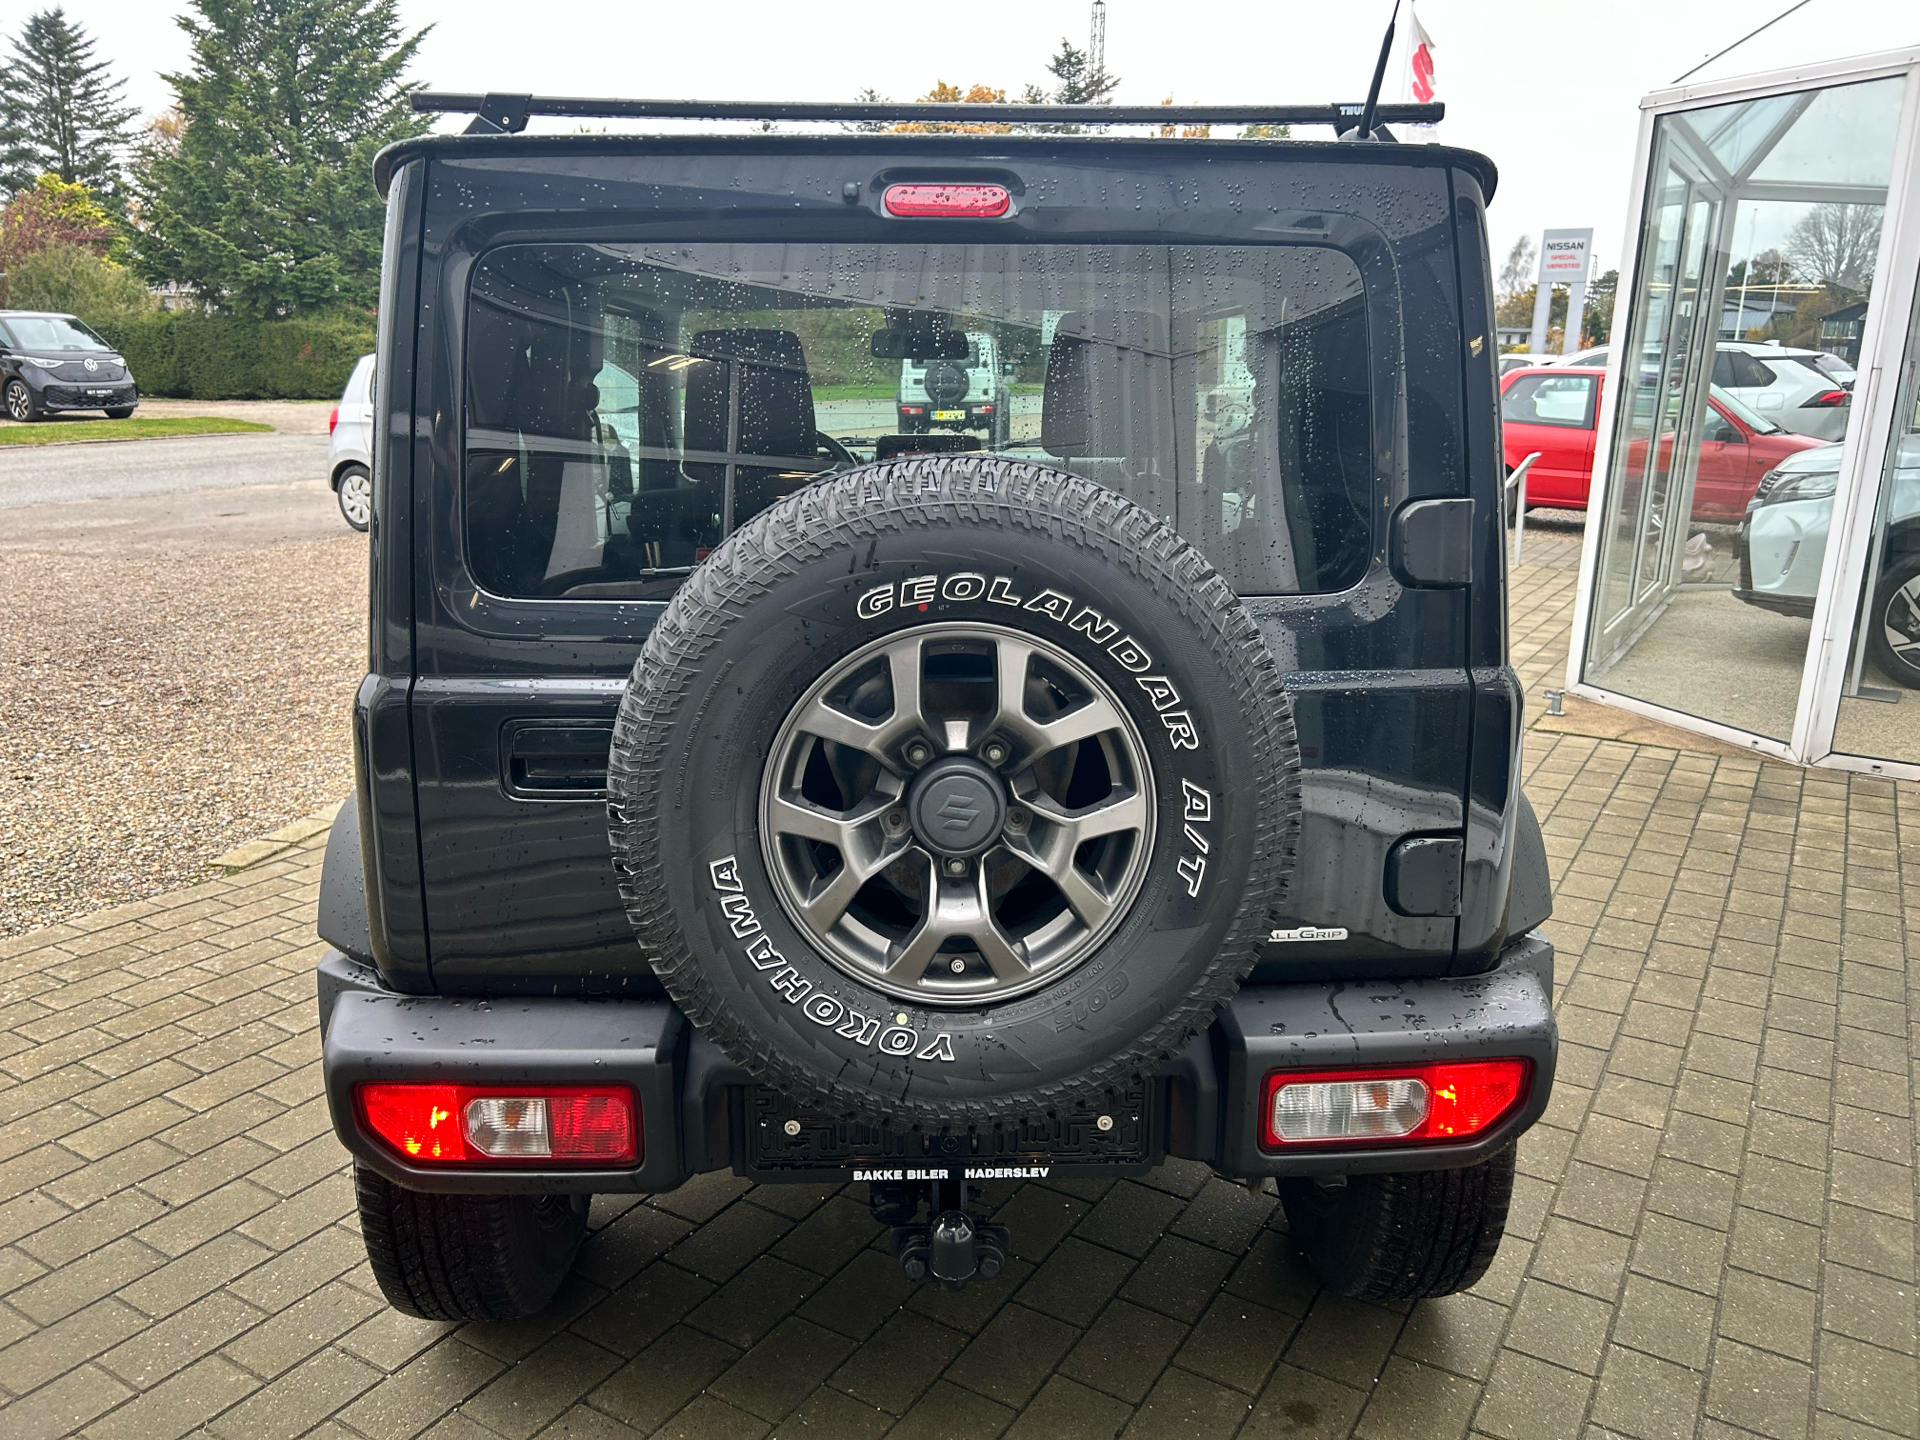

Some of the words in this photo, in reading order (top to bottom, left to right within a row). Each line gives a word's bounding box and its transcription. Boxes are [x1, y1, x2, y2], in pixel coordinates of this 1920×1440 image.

[1340, 105, 1365, 115] THU
[1546, 241, 1585, 251] NISSAN
[856, 572, 1200, 751] GEOLANDAR
[1176, 777, 1212, 898] A/T
[708, 854, 956, 1062] YOKOHAMA
[853, 1170, 903, 1181] BAKKE
[906, 1169, 949, 1180] BILER
[964, 1167, 1050, 1179] HADERSLEV
